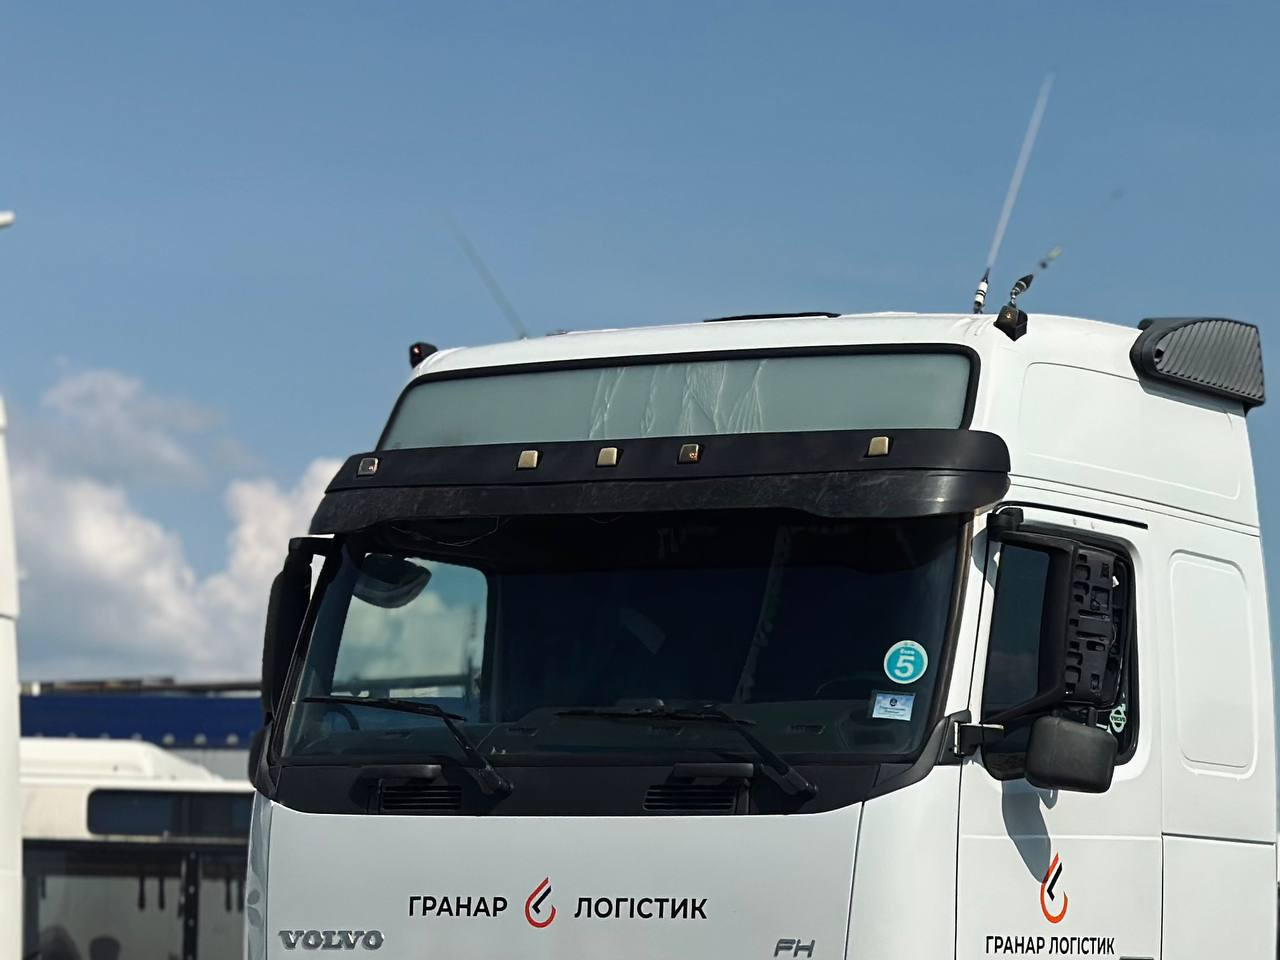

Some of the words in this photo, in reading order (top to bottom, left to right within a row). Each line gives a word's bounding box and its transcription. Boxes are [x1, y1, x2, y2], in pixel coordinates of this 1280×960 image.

[894, 654, 915, 678] 5
[408, 895, 508, 918] ГРАНАР
[574, 896, 708, 920] ЛОГІСТИК
[278, 930, 385, 951] VOLVO
[773, 938, 816, 959] FH
[985, 935, 1046, 955] ГРАНАР
[1048, 936, 1115, 955] ЛОГІСТИК
